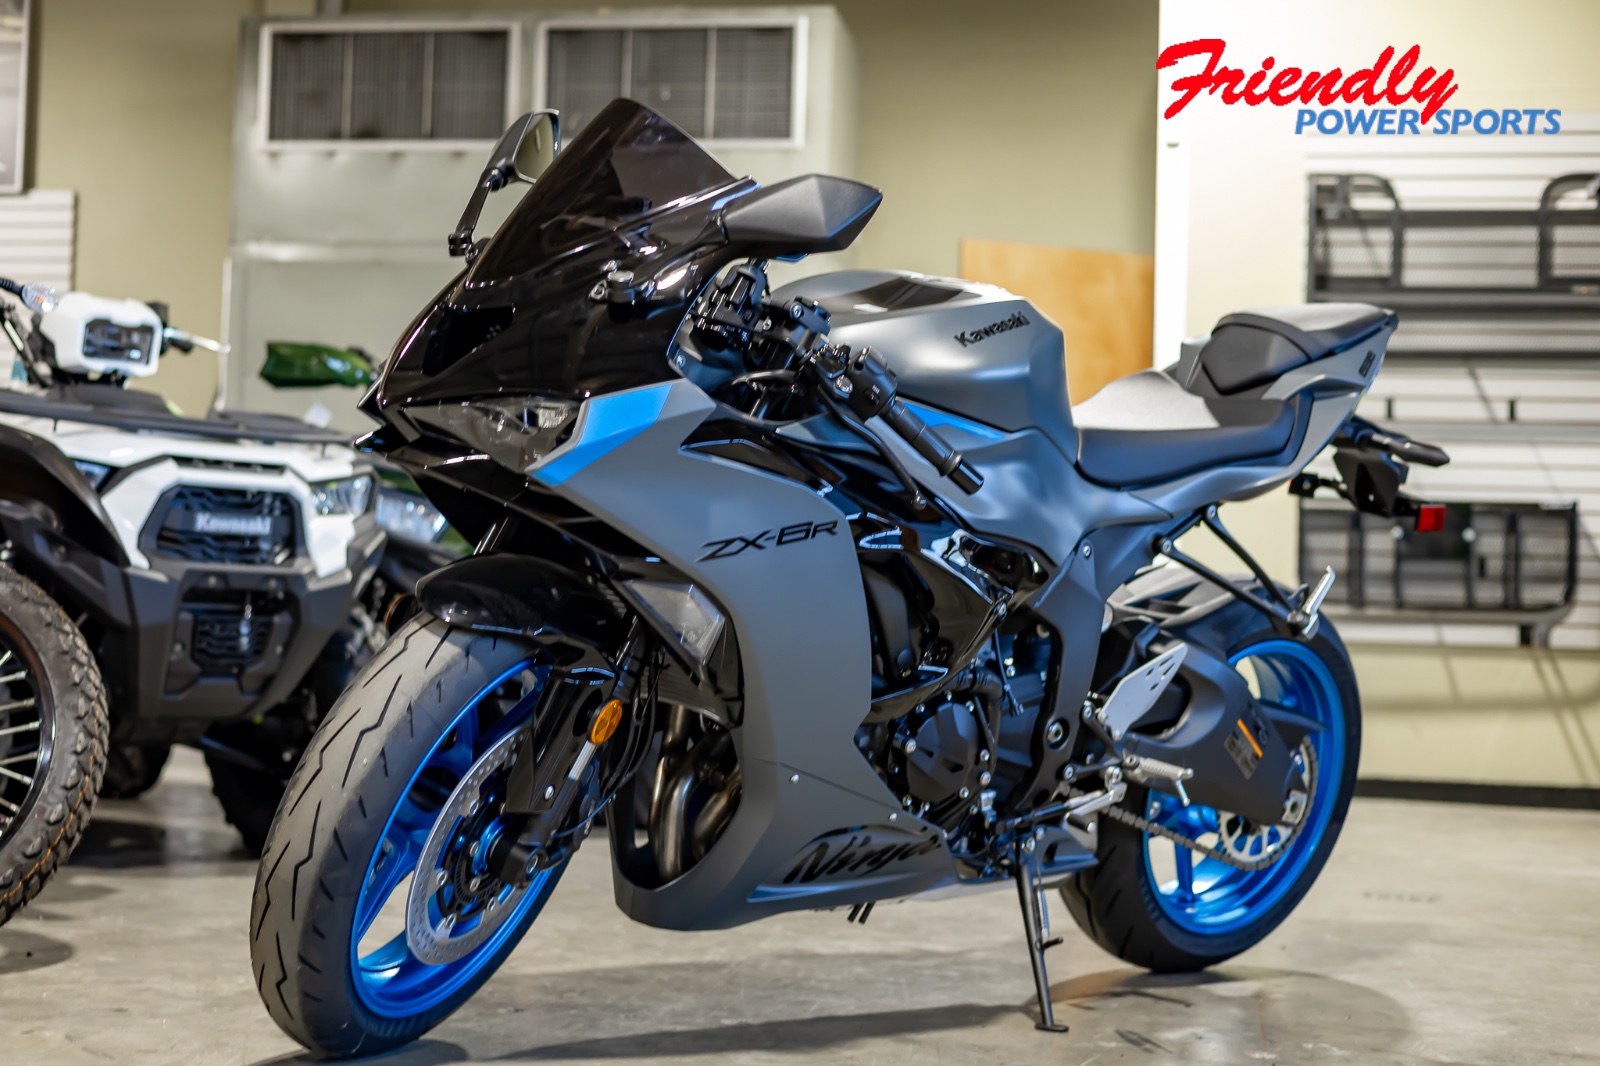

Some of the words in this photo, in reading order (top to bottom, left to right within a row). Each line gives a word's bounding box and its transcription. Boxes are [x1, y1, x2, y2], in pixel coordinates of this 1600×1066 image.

[954, 311, 1030, 347] Kawasaki
[695, 520, 838, 563] ZX-6R
[783, 834, 942, 884] Ninja
